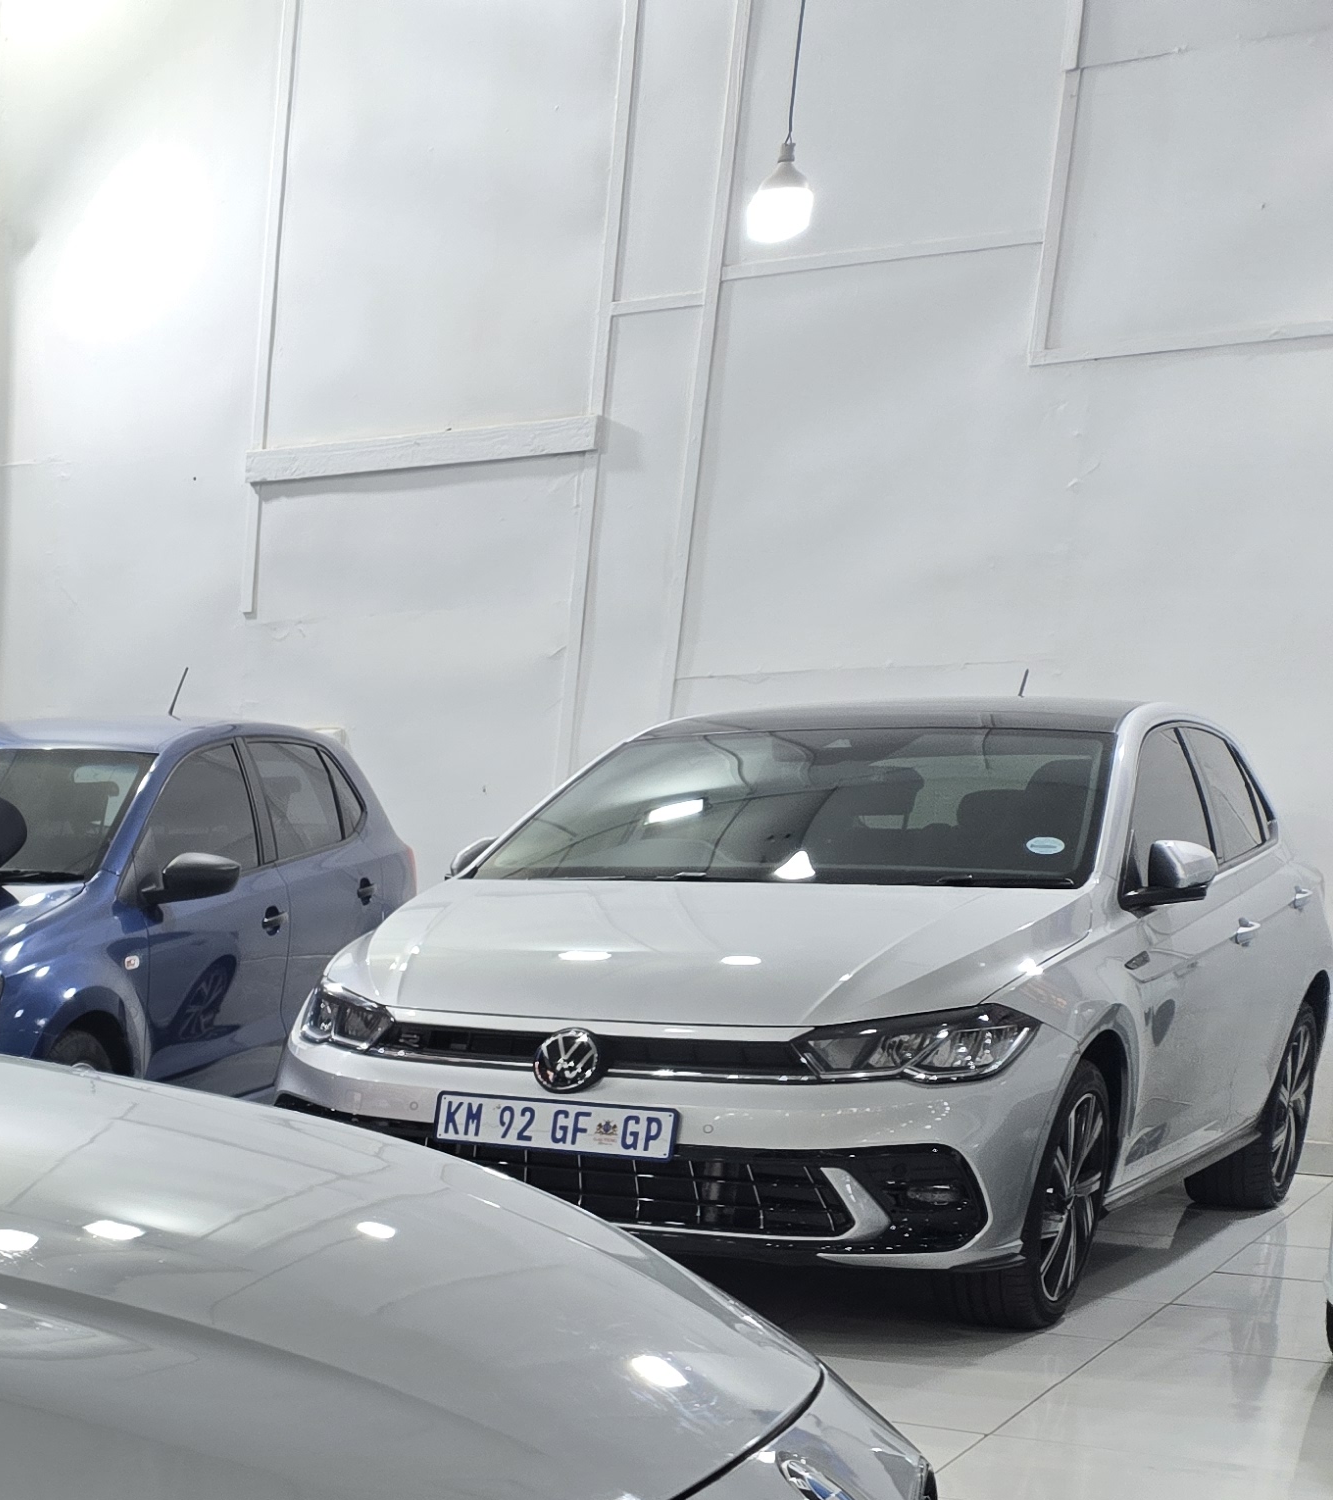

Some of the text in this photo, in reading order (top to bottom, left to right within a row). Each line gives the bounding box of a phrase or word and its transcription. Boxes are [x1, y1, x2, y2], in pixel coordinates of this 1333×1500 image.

[443, 1100, 663, 1152] KM 92 GF GP
